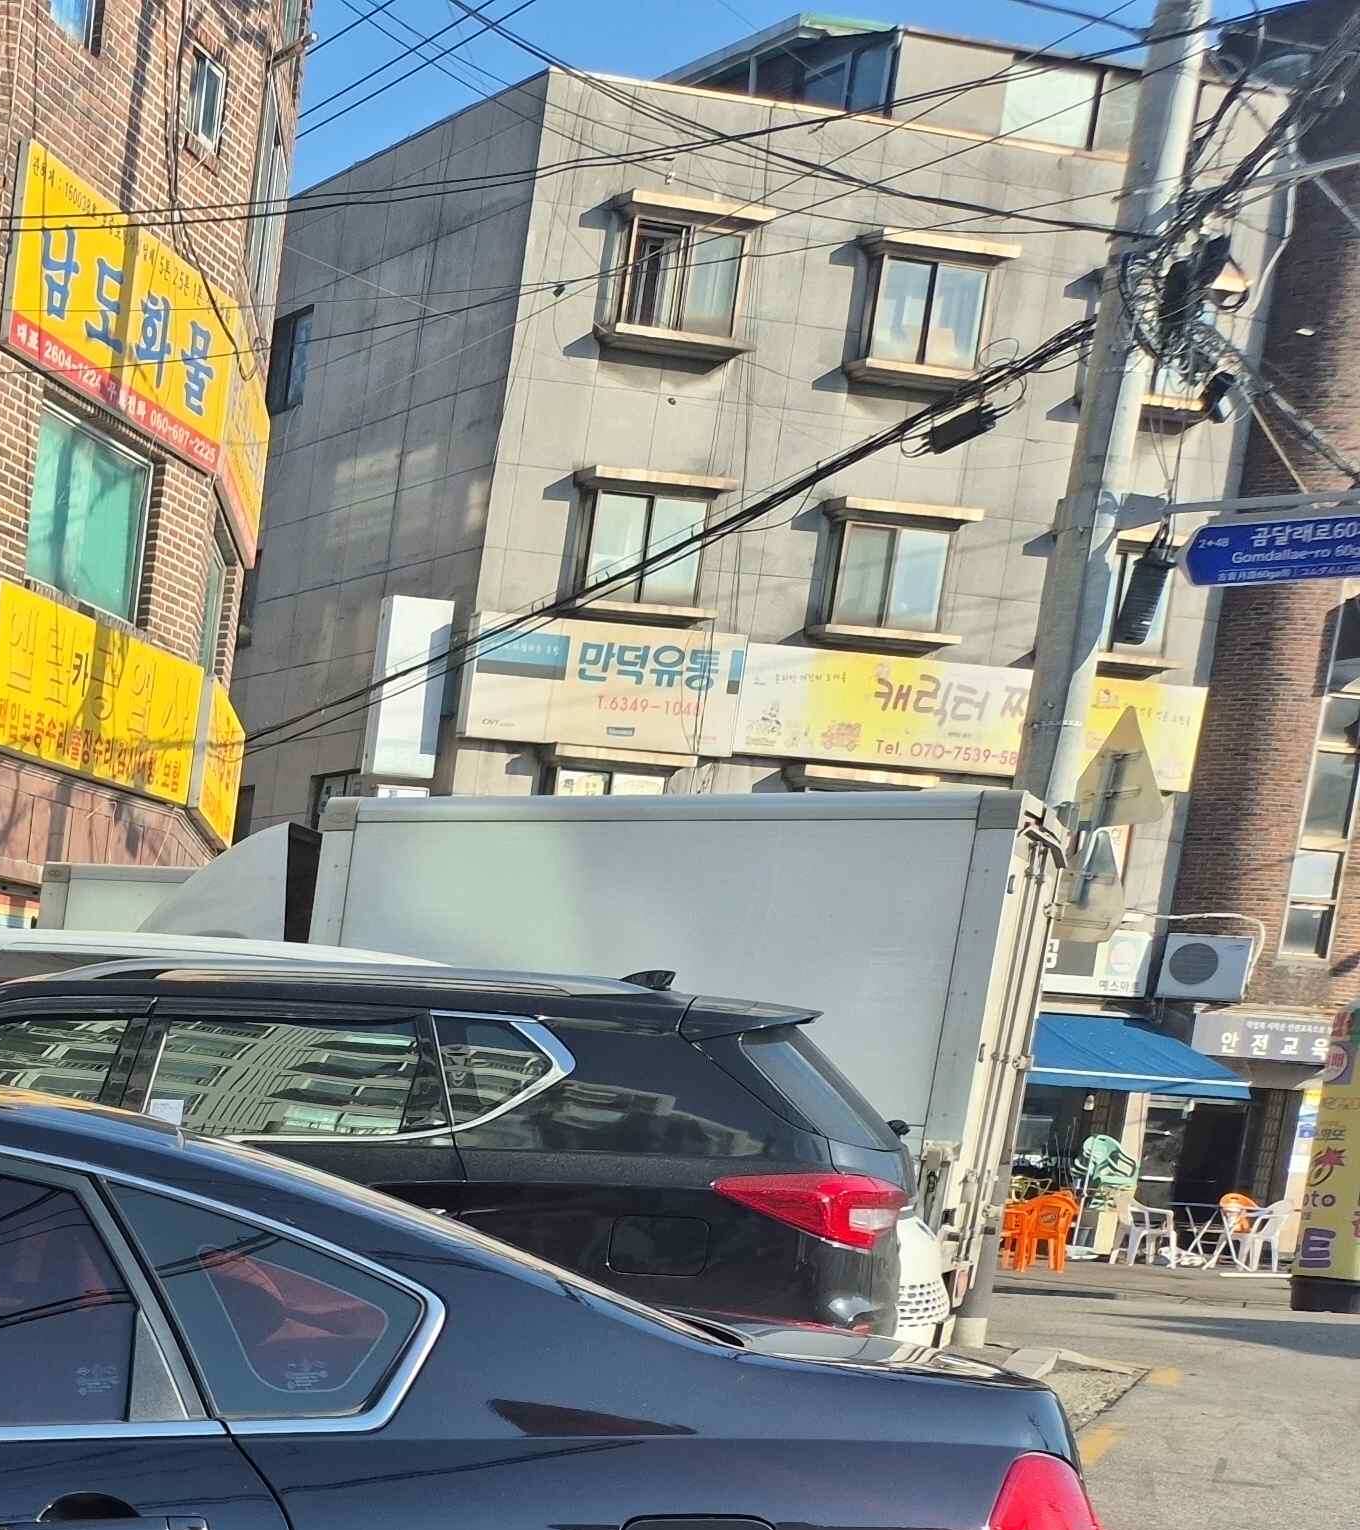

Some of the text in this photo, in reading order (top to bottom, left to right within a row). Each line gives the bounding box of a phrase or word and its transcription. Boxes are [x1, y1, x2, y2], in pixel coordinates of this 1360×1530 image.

[41, 224, 216, 417] 남도화물
[1251, 521, 1360, 547] 곰달래로60
[578, 641, 721, 692] 만덕유통
[874, 673, 991, 727] 캐릭터
[911, 742, 1017, 767] 070-7539-58
[1220, 1031, 1330, 1061] 안전교육
